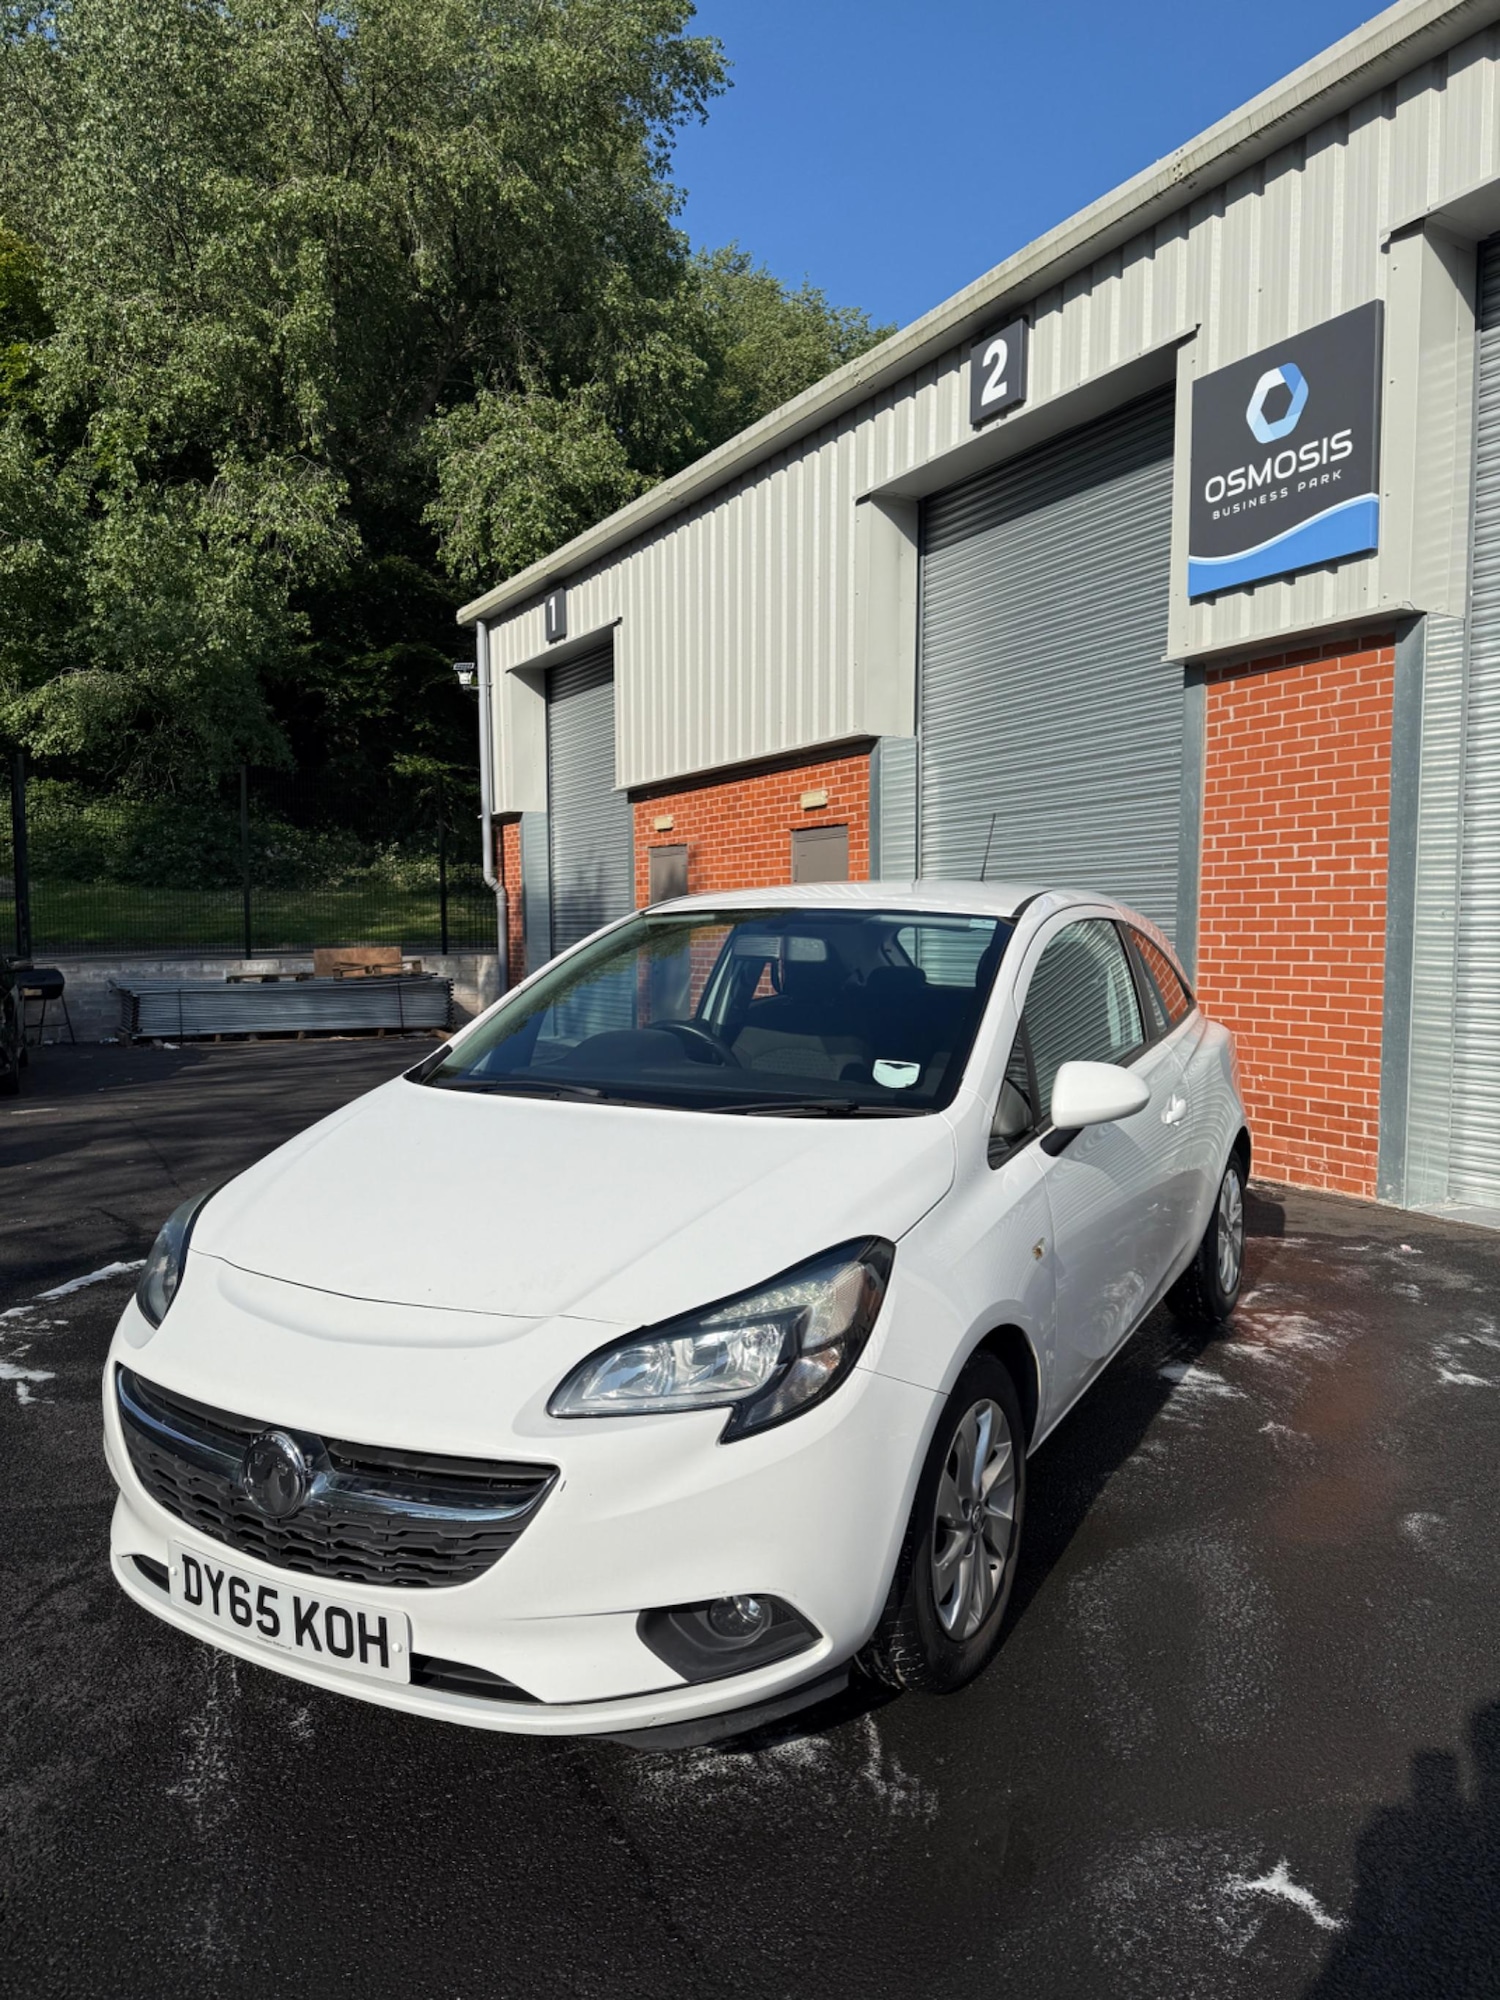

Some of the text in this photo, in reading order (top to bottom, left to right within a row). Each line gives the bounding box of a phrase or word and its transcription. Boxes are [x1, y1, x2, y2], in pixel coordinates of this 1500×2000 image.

[981, 339, 1007, 406] 2
[1205, 428, 1353, 503] OSMOSIS
[1212, 470, 1342, 520] BUSINESS PARK
[549, 596, 556, 632] 1
[182, 1554, 389, 1668] DY65 KOH
